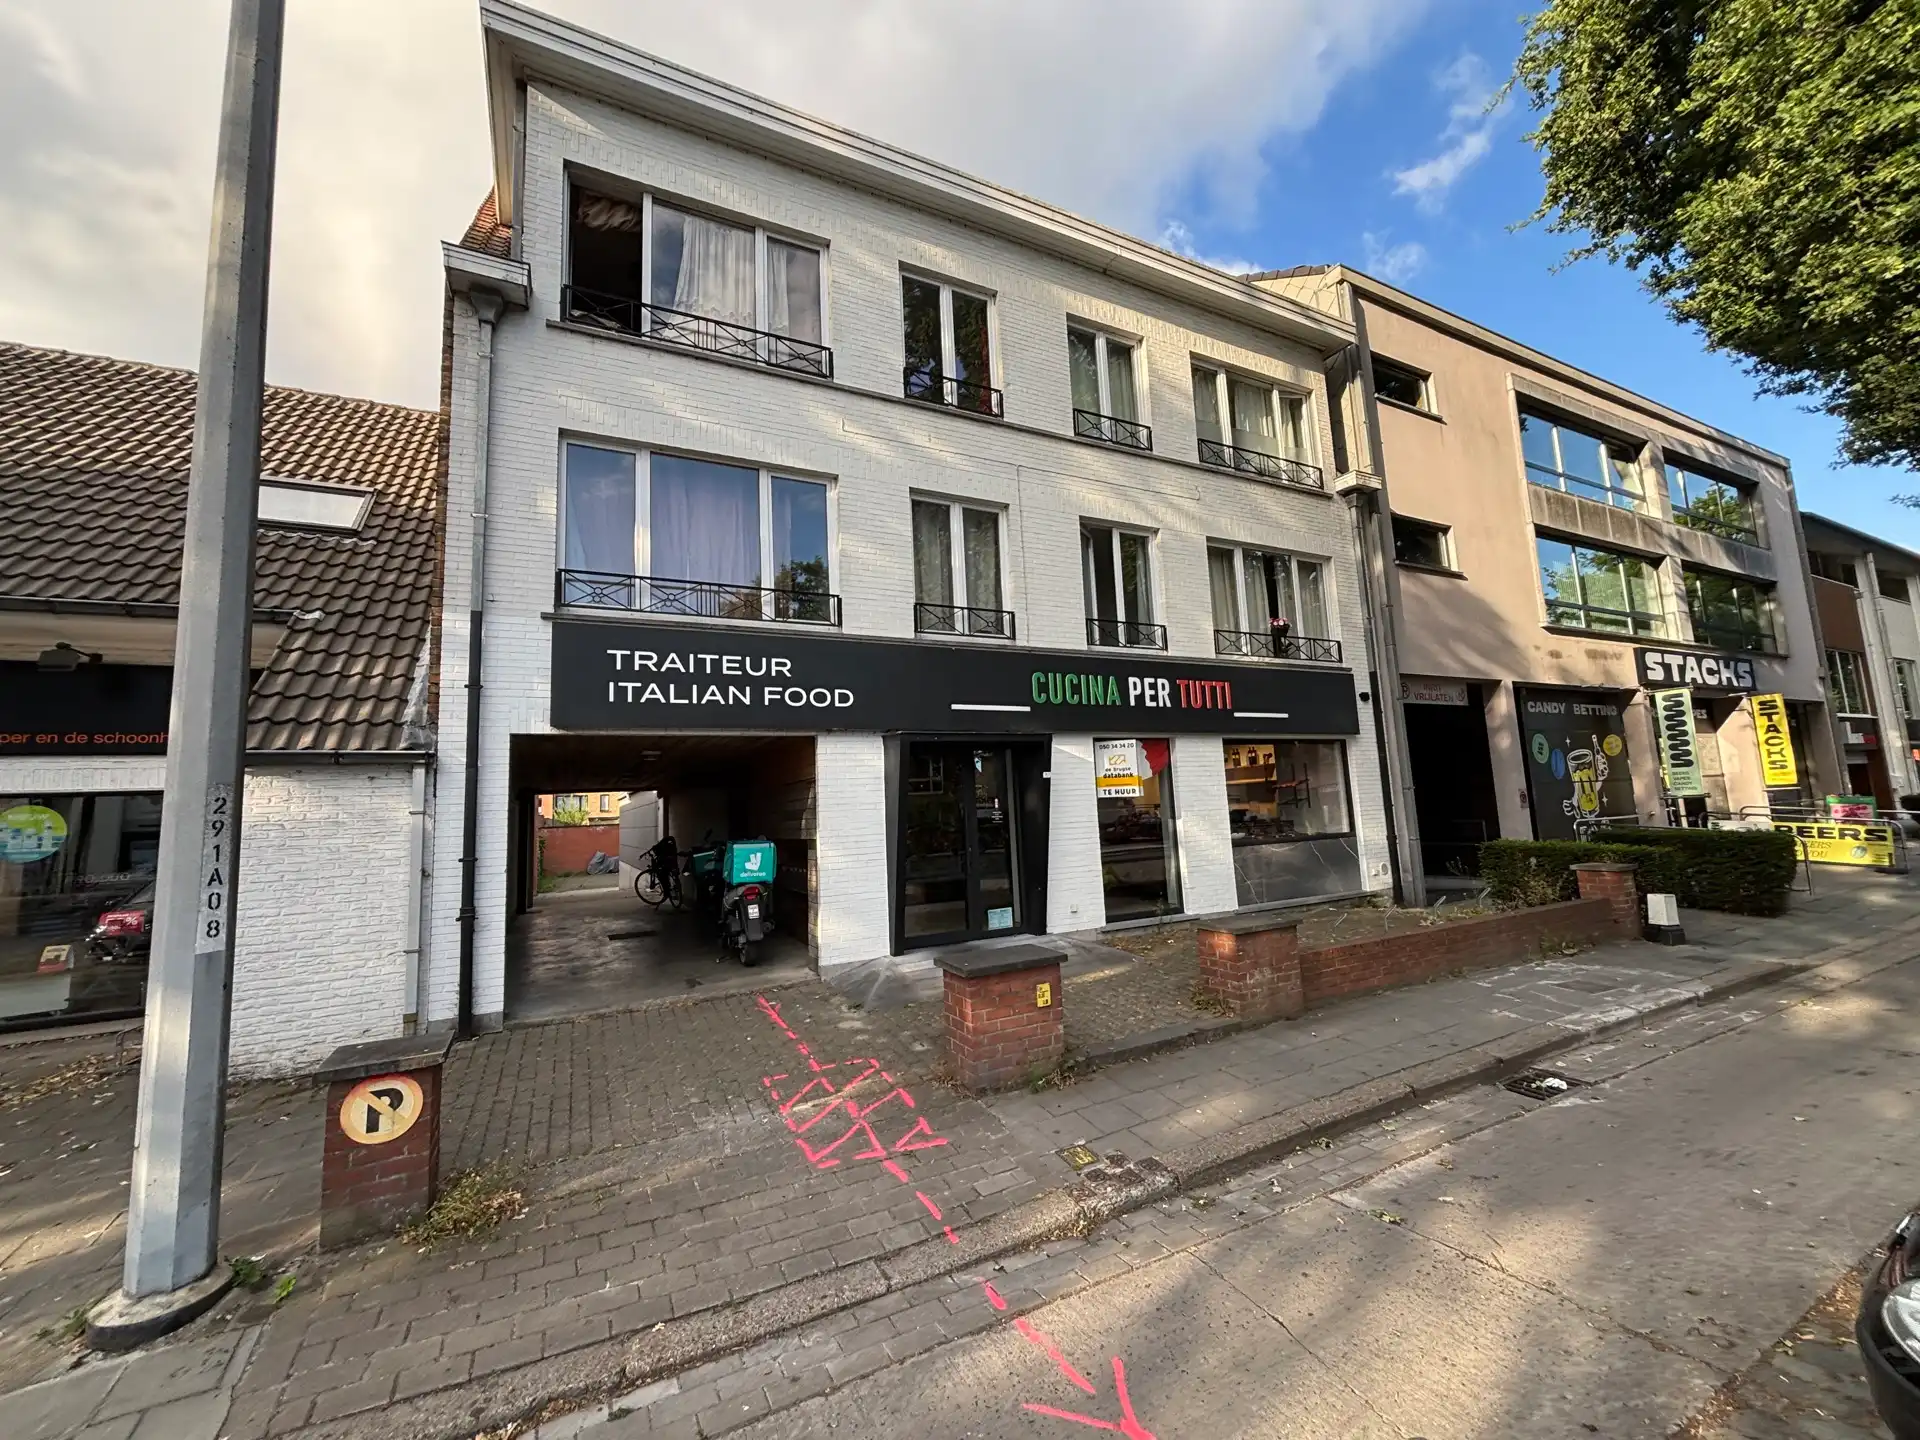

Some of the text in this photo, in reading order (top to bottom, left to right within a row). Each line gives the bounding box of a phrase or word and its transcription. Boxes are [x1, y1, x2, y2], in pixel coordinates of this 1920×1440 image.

[606, 648, 792, 678] TRAITEUR
[1645, 651, 1753, 688] STACKS
[607, 681, 854, 708] ITALIAN FOOD
[1031, 671, 1232, 710] CUCINA PER TUTTI
[1527, 702, 1619, 716] CANDY BETTING
[36, 733, 59, 744] en
[64, 731, 89, 744] de
[1757, 699, 1789, 770] STACKS
[205, 796, 228, 939] 291A08
